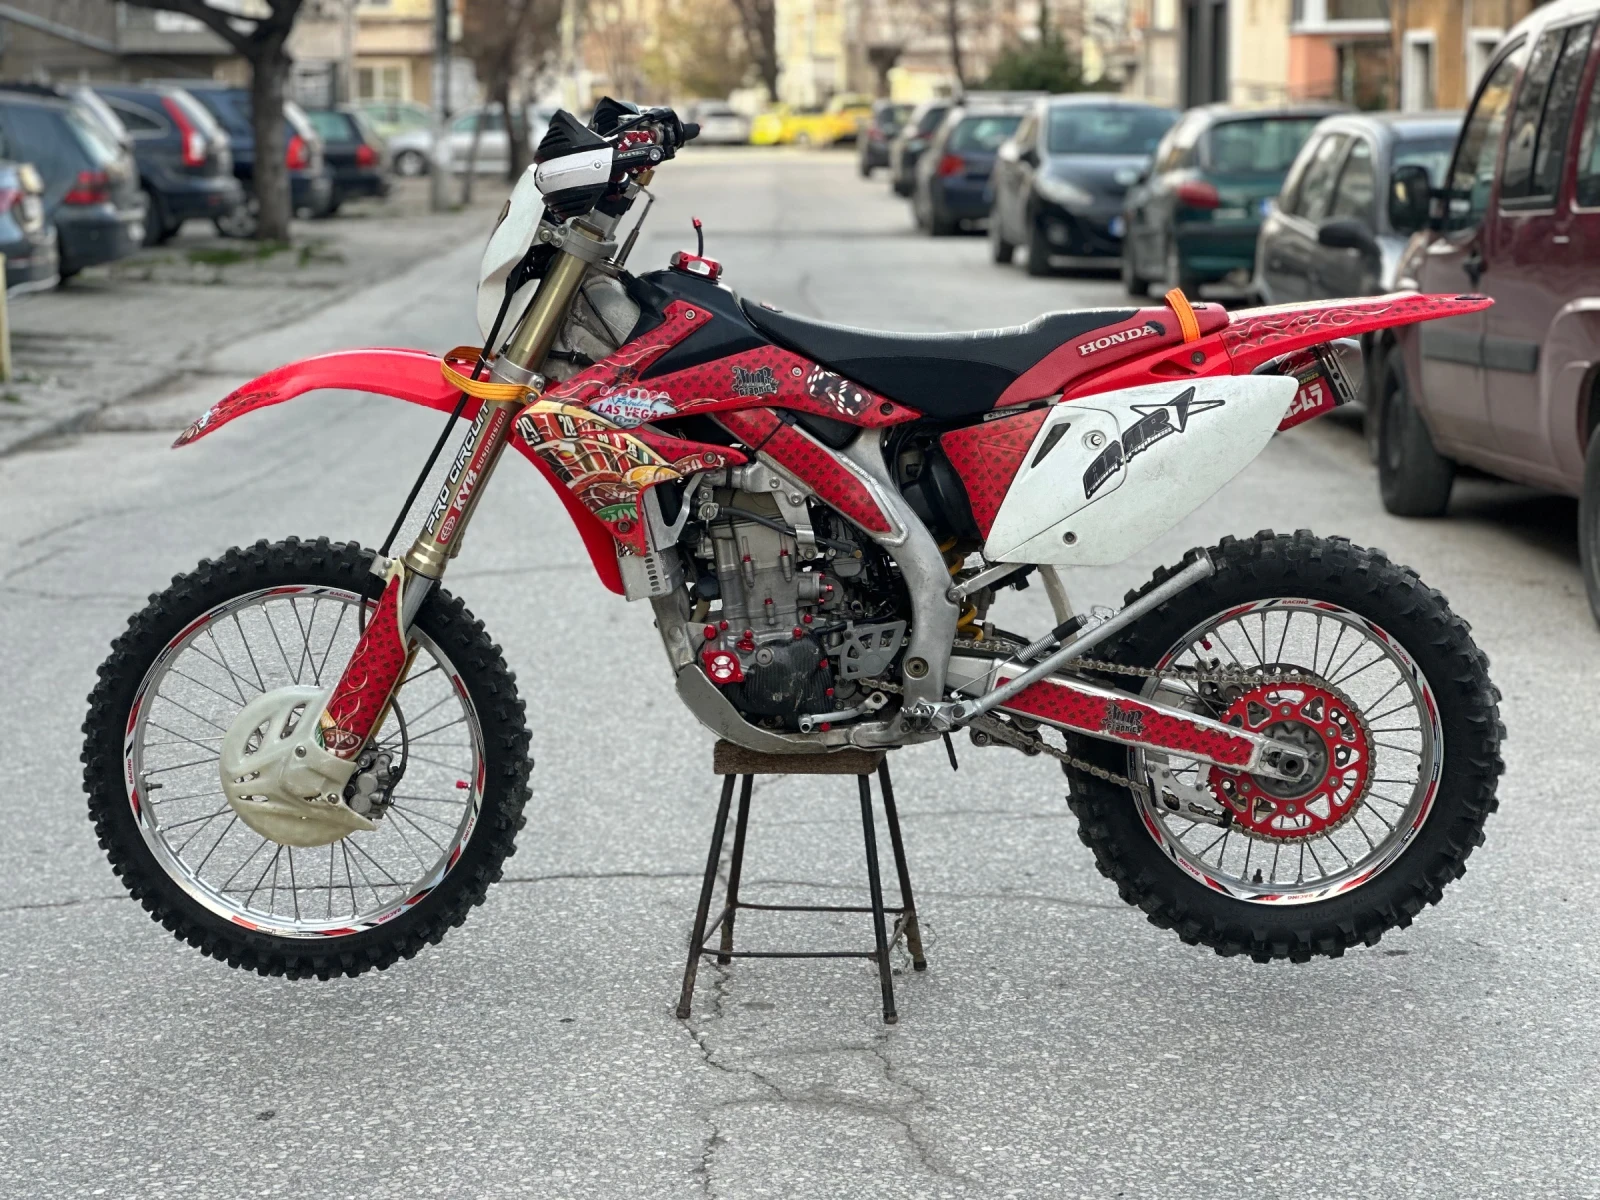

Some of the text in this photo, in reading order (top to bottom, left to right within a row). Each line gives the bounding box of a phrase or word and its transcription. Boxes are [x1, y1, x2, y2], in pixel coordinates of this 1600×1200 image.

[1078, 325, 1158, 356] HONDA
[598, 403, 621, 415] LAS
[515, 416, 541, 445] 29
[540, 414, 553, 437] 7
[559, 415, 578, 436] 28
[425, 399, 490, 536] PRO CIRCUIT
[453, 410, 506, 512] KYB suspension
[329, 591, 356, 600] RACING
[1391, 643, 1412, 666] RACING
[463, 817, 475, 842] RACING
[1178, 857, 1201, 876] RACING
[378, 907, 402, 922] RACING
